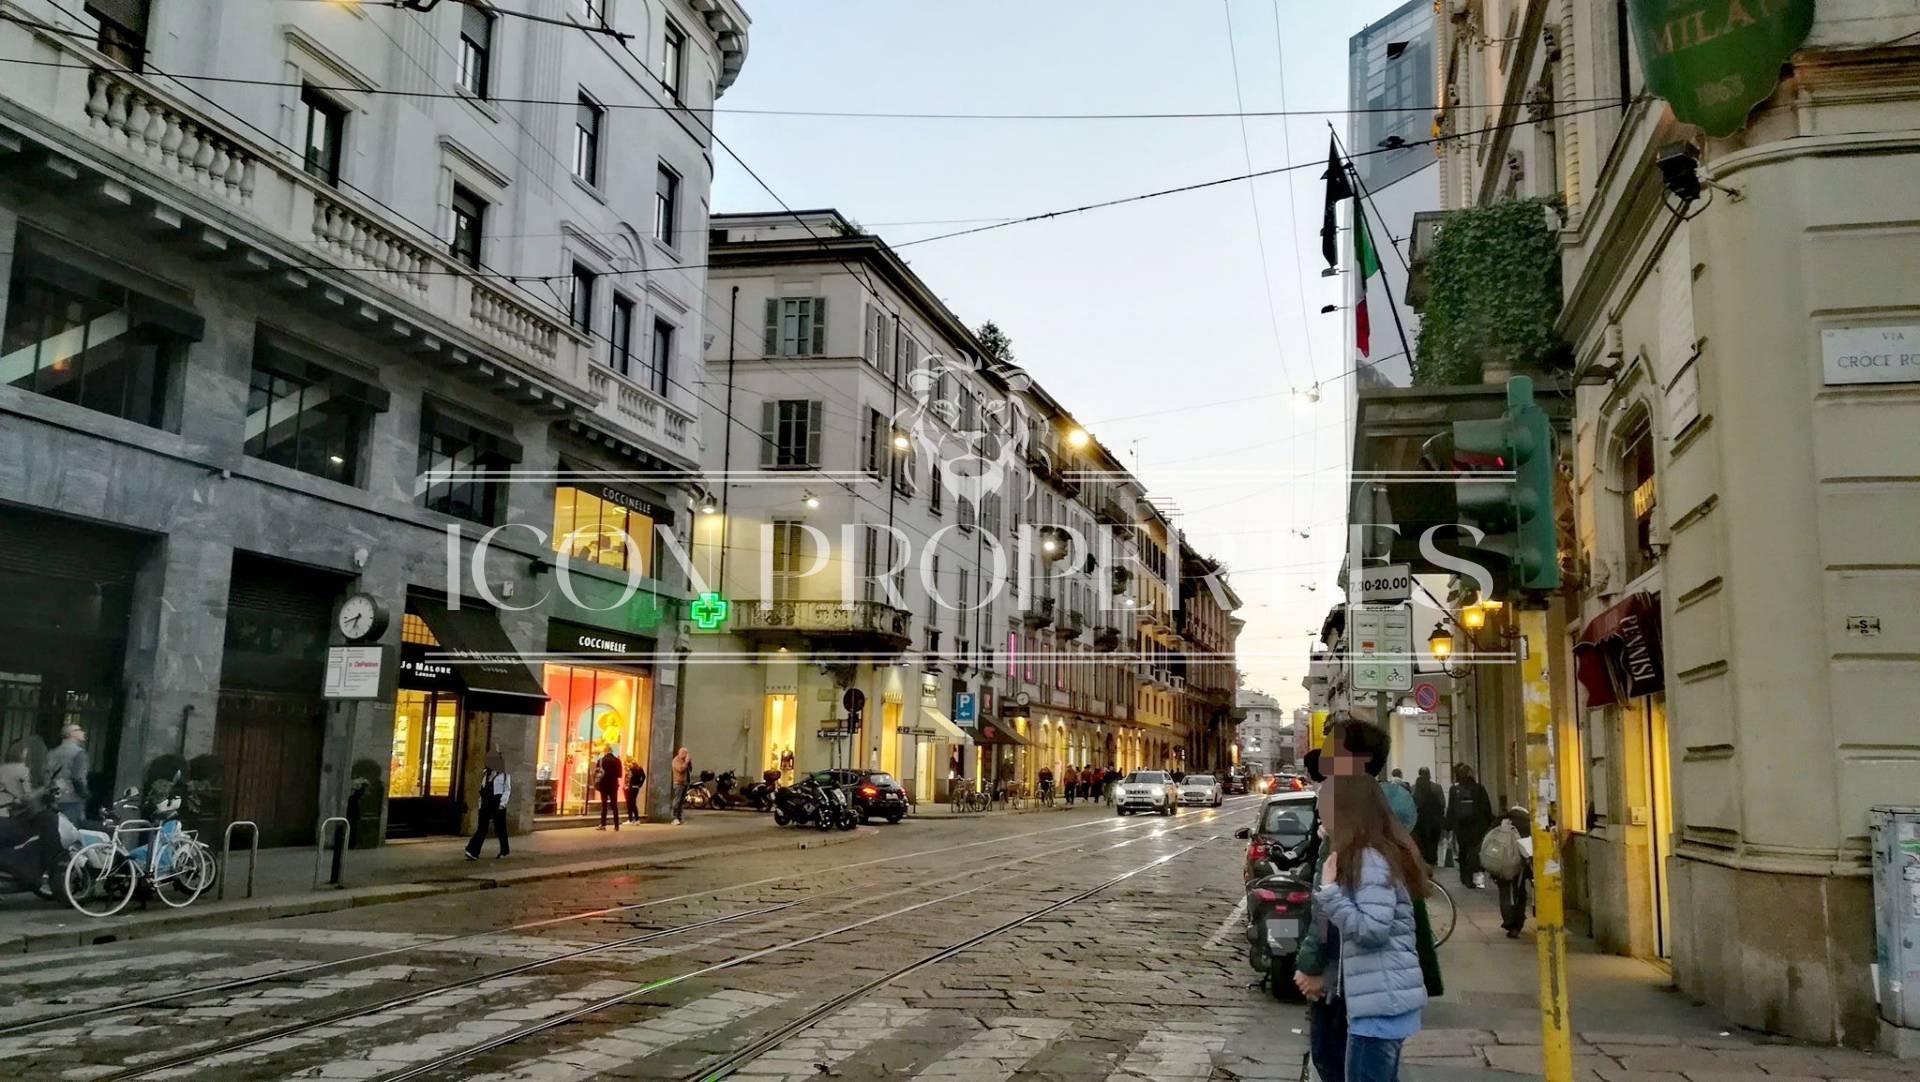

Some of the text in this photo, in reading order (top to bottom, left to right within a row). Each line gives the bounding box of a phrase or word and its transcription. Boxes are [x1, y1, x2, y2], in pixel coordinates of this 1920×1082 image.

[1882, 332, 1905, 341] VIA
[1838, 354, 1892, 368] CROCE
[602, 487, 651, 514] COCCINELLE
[578, 636, 627, 653] COCCINELLE
[1620, 614, 1656, 681] PENNISI
[959, 695, 970, 708] P
